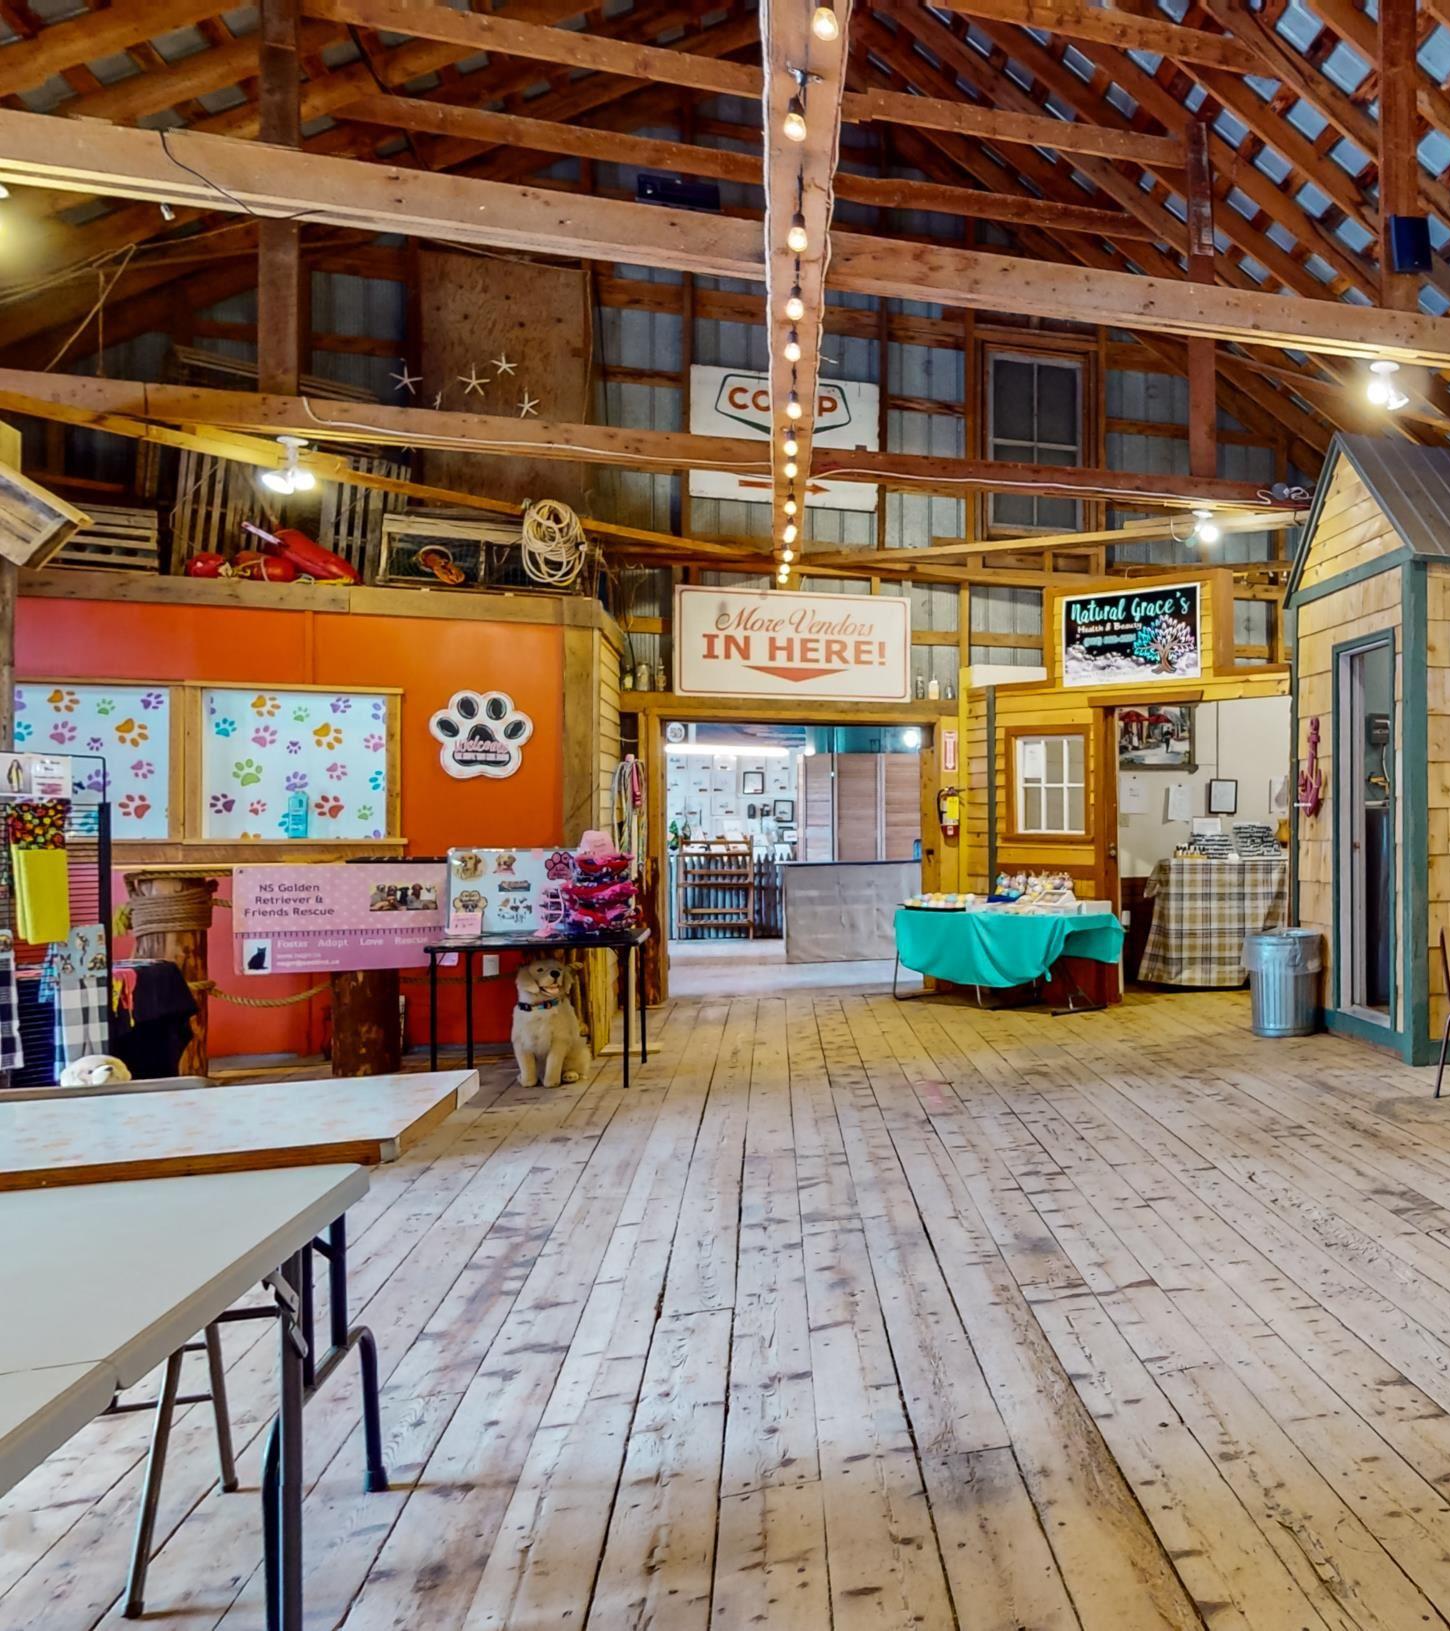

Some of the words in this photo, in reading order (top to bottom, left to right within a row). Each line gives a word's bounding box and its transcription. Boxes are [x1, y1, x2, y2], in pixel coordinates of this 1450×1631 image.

[728, 386, 838, 417] COP
[1070, 598, 1127, 625] Natural
[1130, 591, 1191, 622] Grace's
[714, 606, 785, 633] More
[788, 608, 875, 637] Vendors
[1077, 624, 1104, 634] Health
[1105, 622, 1112, 632] &
[1113, 621, 1143, 632] Beauty
[701, 633, 751, 661] IN
[768, 636, 887, 666] HERE!
[258, 884, 274, 893] NS
[278, 882, 320, 893] Golden
[255, 895, 312, 905] Retriever
[315, 895, 324, 904] &
[244, 907, 289, 917] Friends
[292, 907, 335, 917] Rescue
[276, 939, 309, 949] Foster
[318, 938, 349, 949] Adopt
[359, 937, 384, 946] Love
